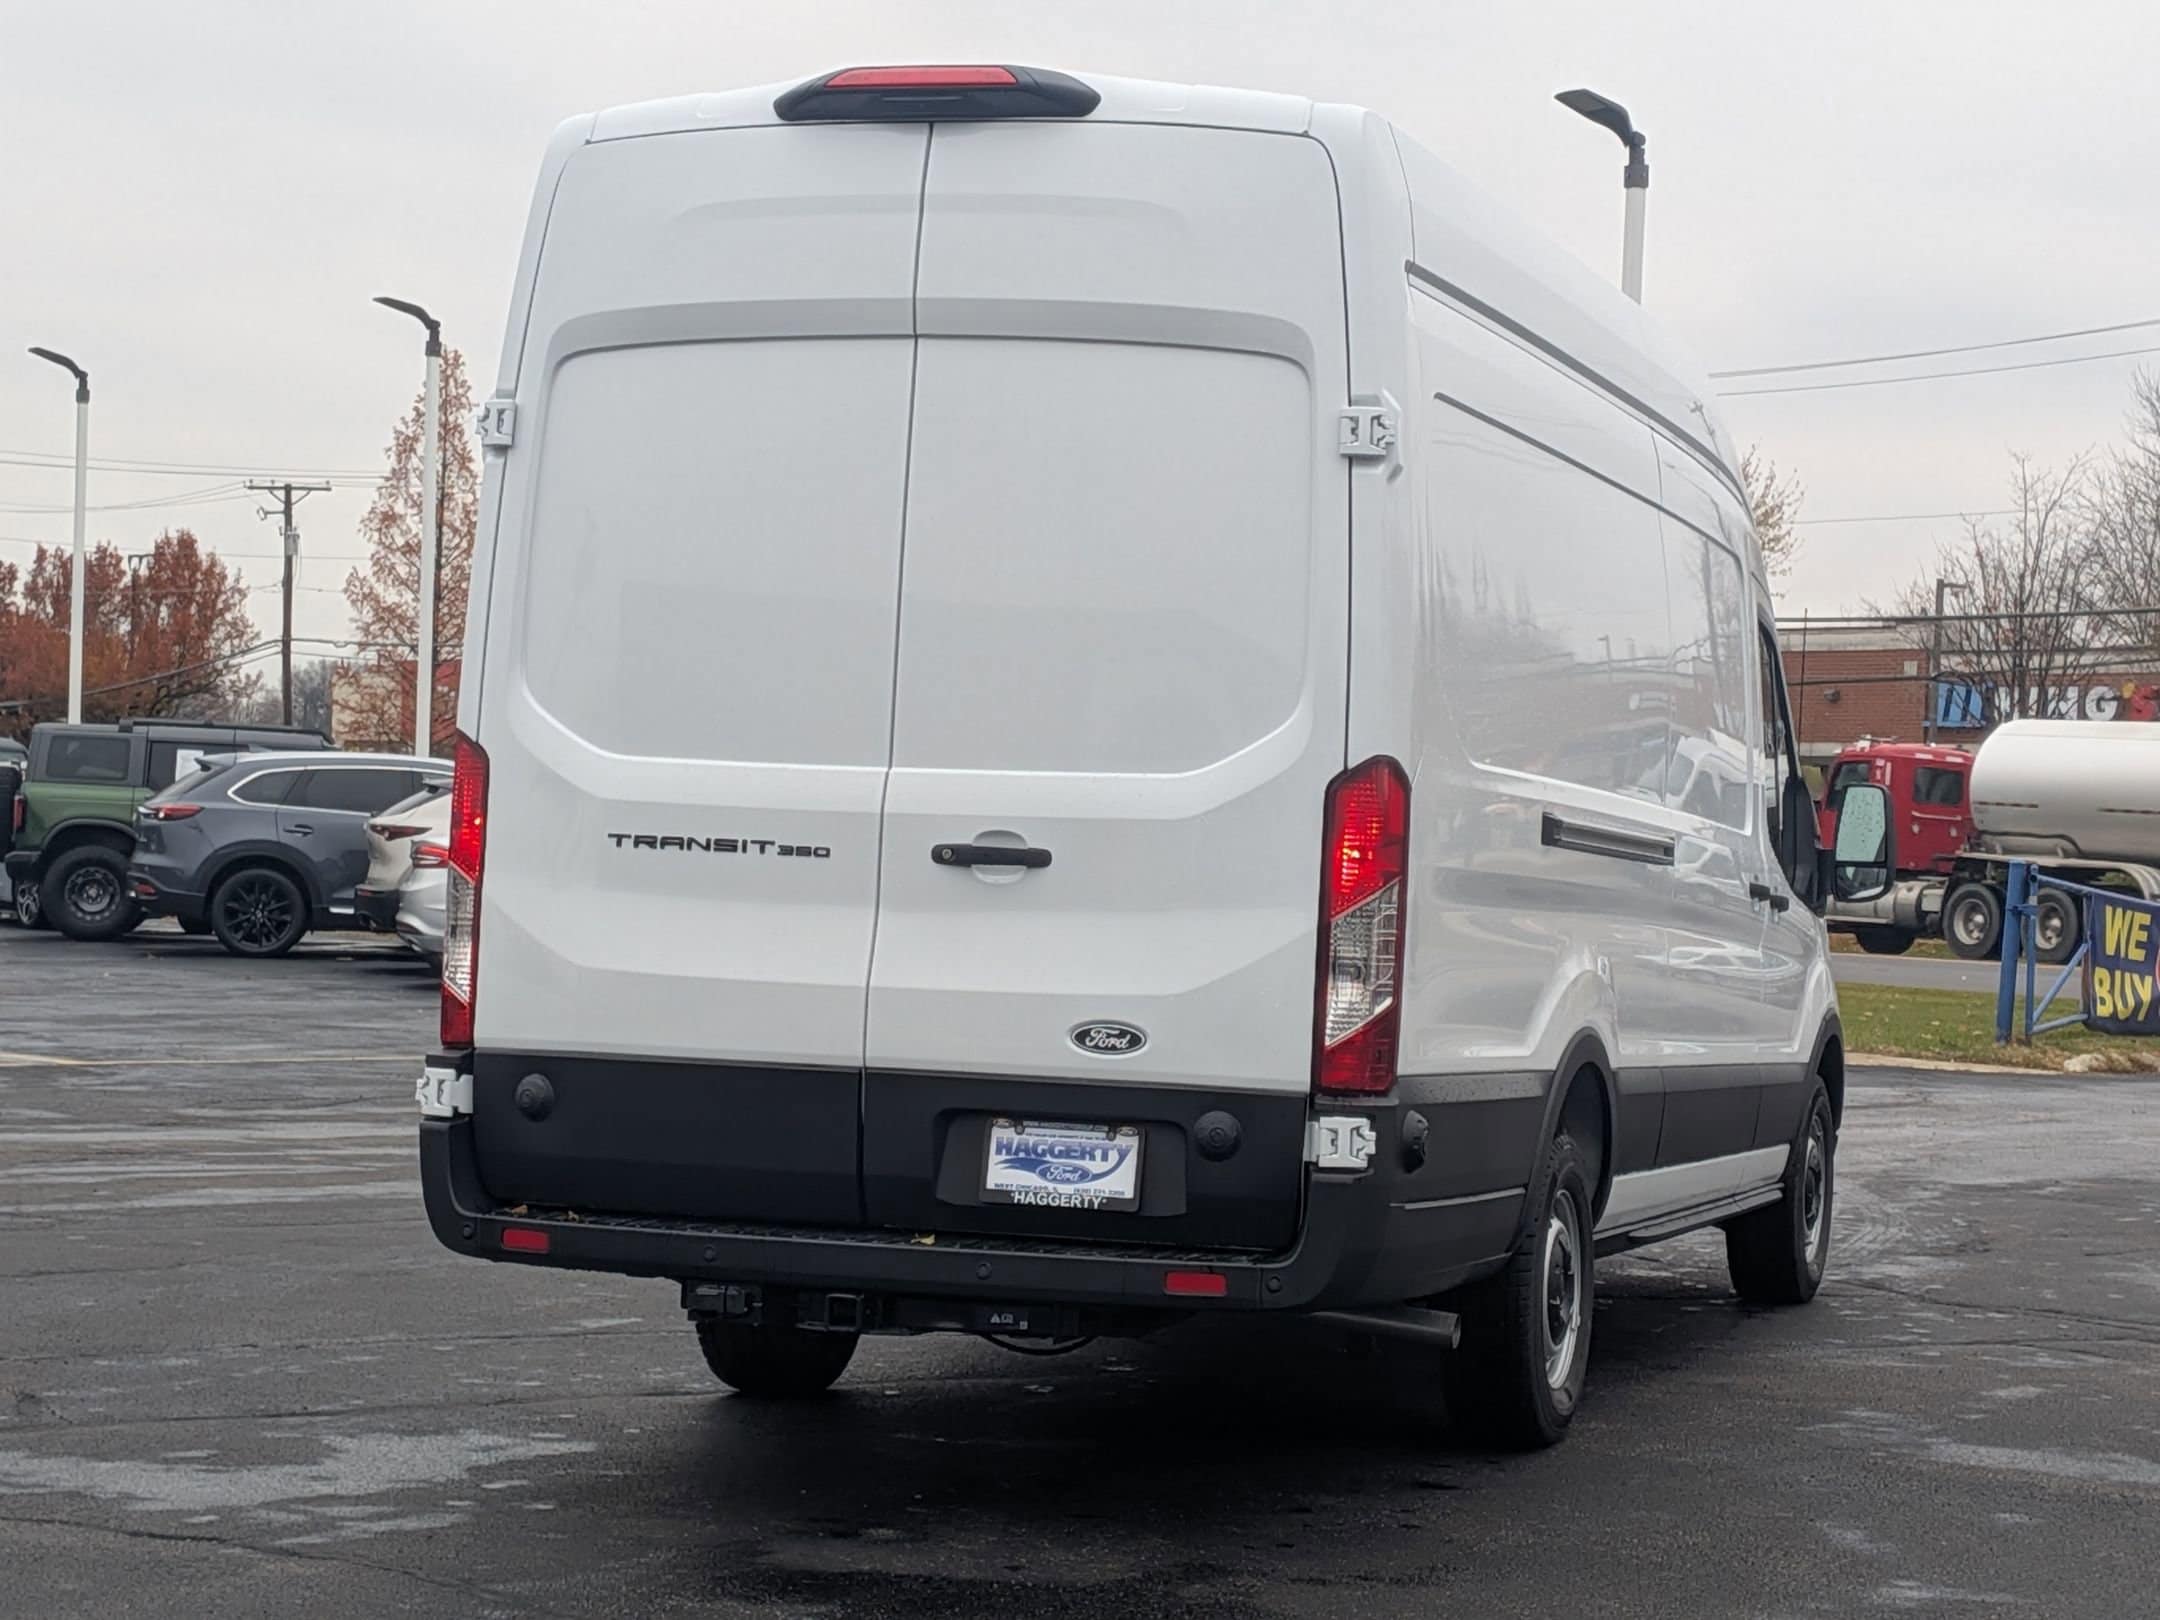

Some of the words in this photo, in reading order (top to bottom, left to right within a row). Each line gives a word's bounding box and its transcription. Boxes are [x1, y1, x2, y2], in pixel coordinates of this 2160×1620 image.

[607, 833, 775, 856] TRANSIT
[2104, 904, 2152, 961] WE
[2094, 966, 2153, 1021] BUY
[1084, 1027, 1132, 1049] Ford
[995, 1136, 1134, 1163] HAGGERTY
[1045, 1166, 1083, 1182] Ford
[1013, 1190, 1104, 1210] HAGGERTY
